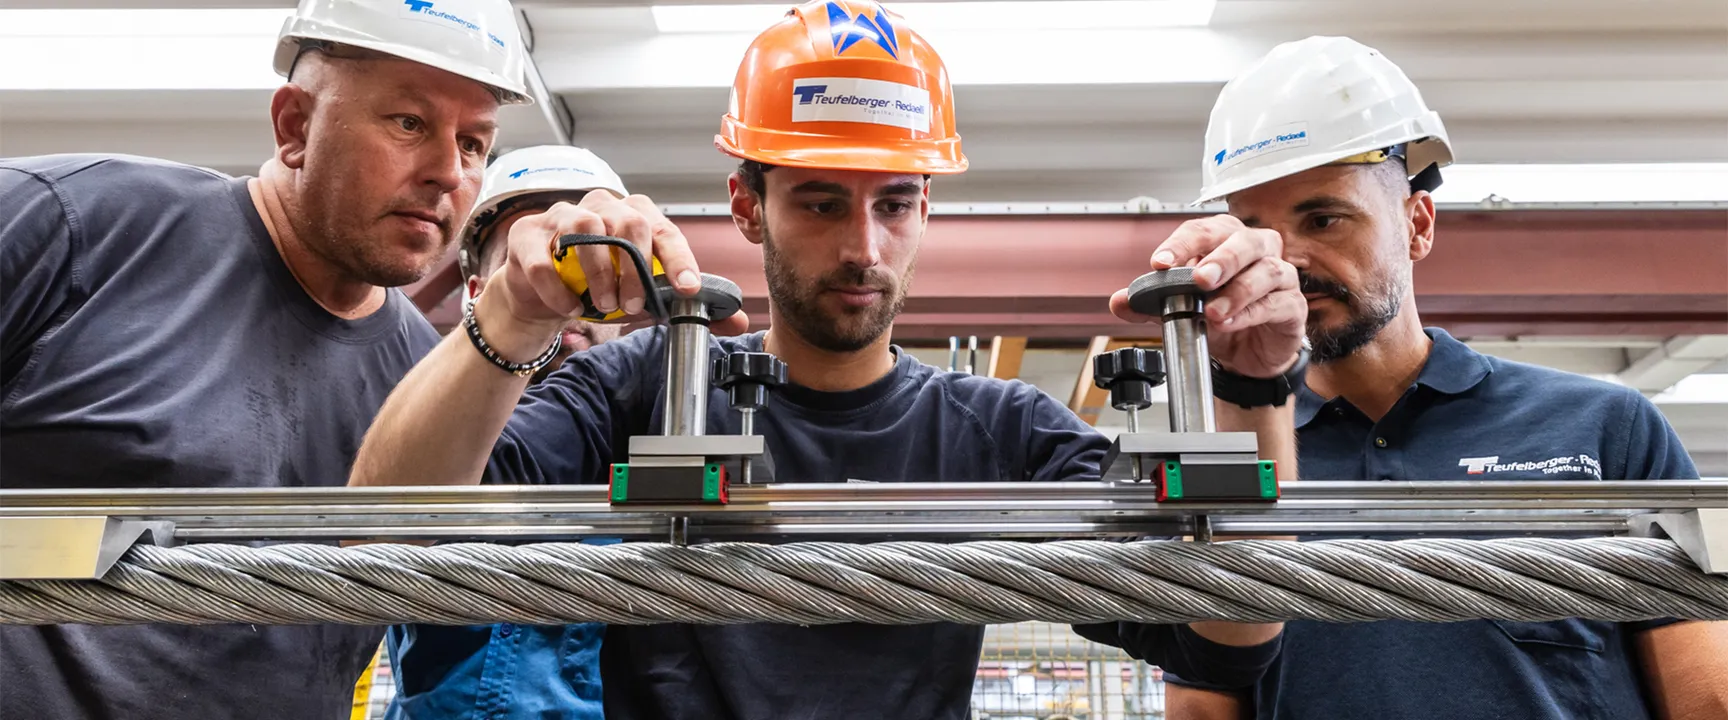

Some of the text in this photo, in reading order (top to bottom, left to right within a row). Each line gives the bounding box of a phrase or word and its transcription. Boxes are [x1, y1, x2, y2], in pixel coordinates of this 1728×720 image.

[815, 94, 890, 108] Teufelberger
[1486, 456, 1574, 473] Teufelberger
[1542, 464, 1582, 475] Together
